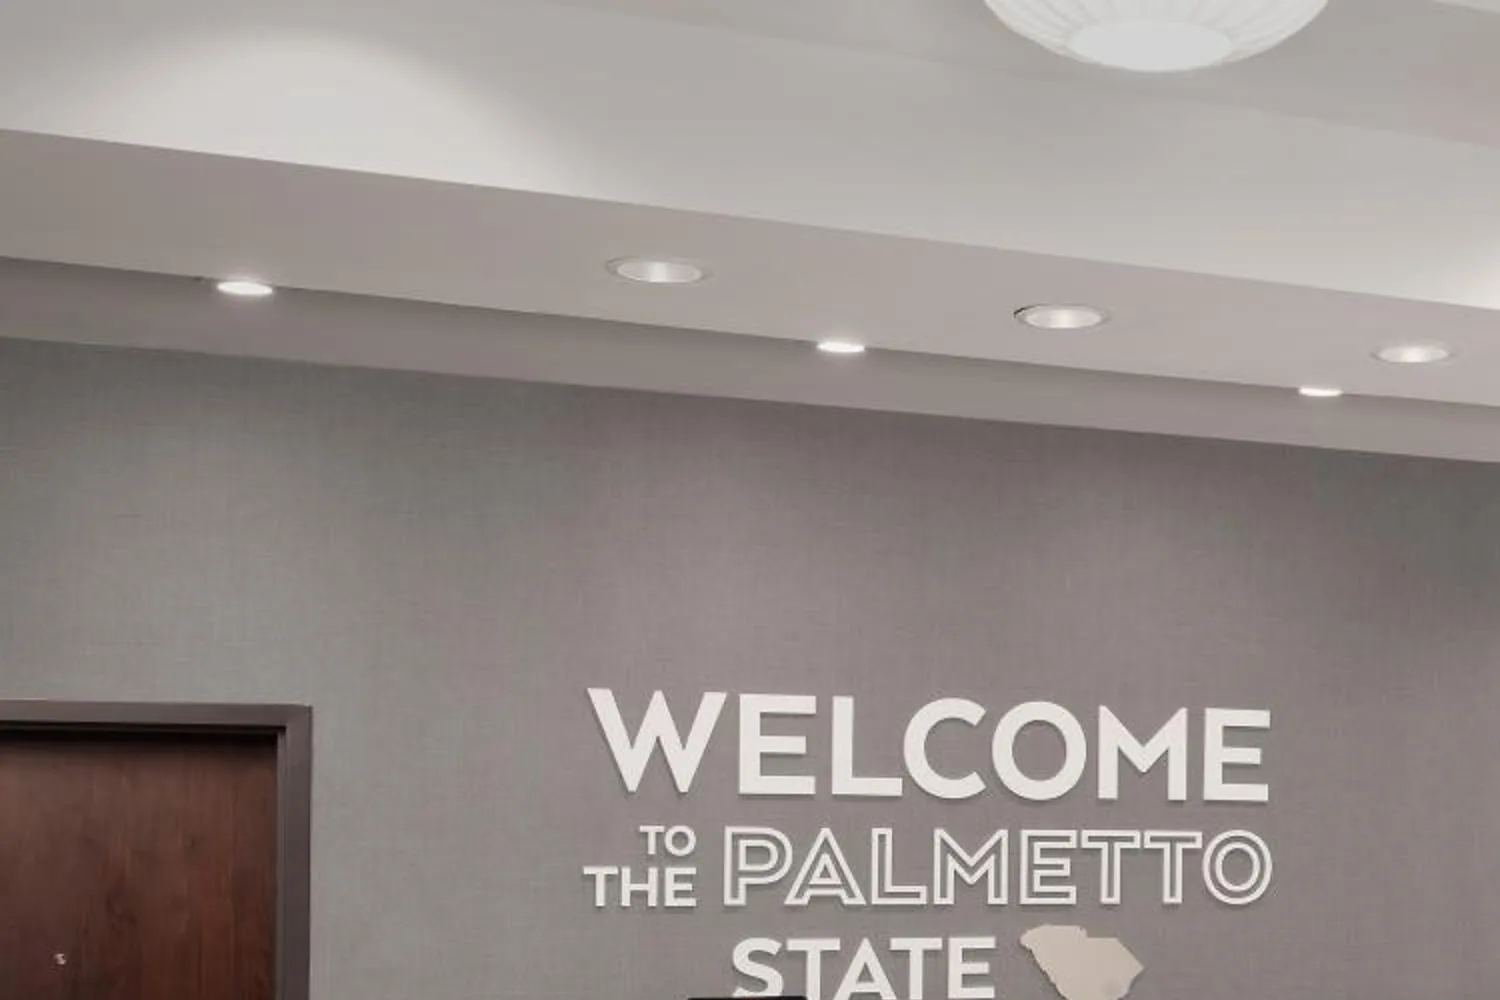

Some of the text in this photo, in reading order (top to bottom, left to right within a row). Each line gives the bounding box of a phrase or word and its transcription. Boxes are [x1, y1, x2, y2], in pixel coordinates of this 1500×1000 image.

[588, 687, 1271, 803] WELCOME
[583, 826, 1273, 907] THE PALMETTO
[639, 825, 697, 857] TO
